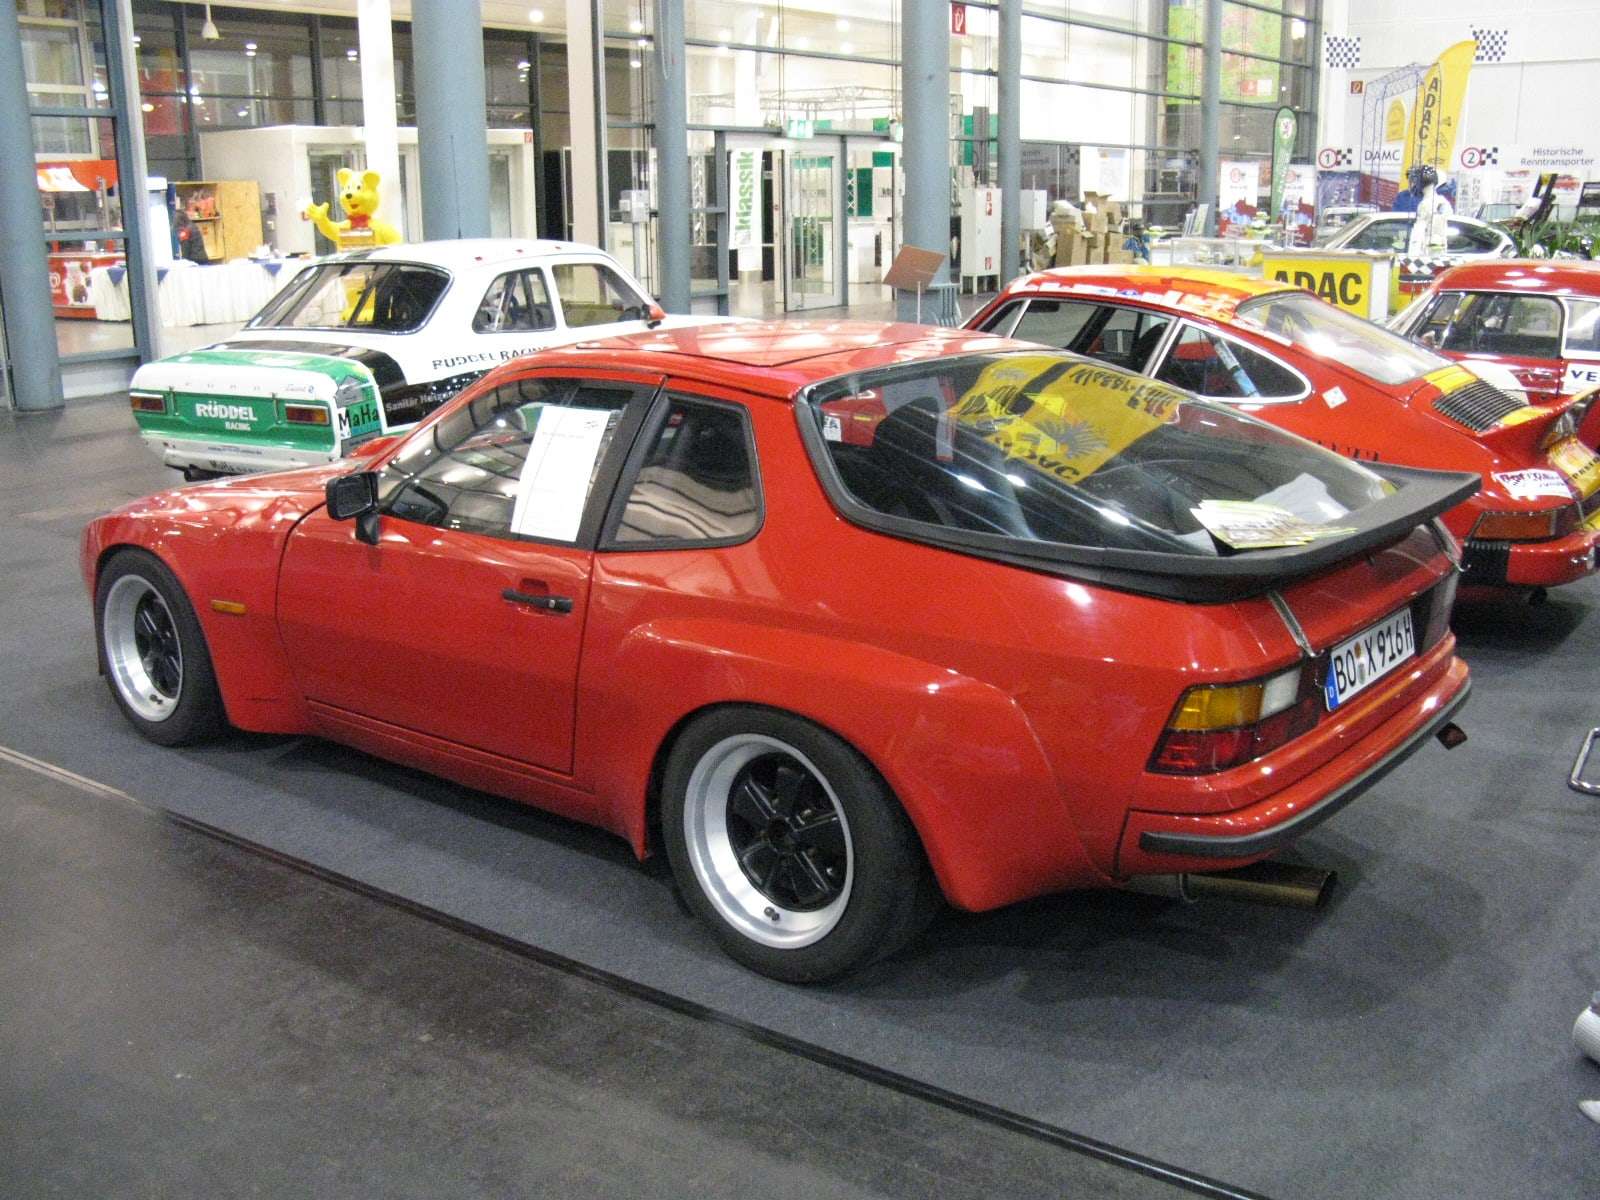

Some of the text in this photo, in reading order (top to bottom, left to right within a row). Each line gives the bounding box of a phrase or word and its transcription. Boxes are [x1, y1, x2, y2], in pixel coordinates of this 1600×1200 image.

[1418, 77, 1439, 140] ADAC
[1364, 150, 1400, 161] DAMC
[1533, 147, 1583, 156] Historische
[1520, 158, 1594, 167] Renntransporter
[500, 346, 549, 361] RAC
[195, 400, 257, 421] RÜDDEL
[338, 403, 379, 430] MaHa
[1334, 648, 1357, 695] BO
[1364, 636, 1377, 677] X
